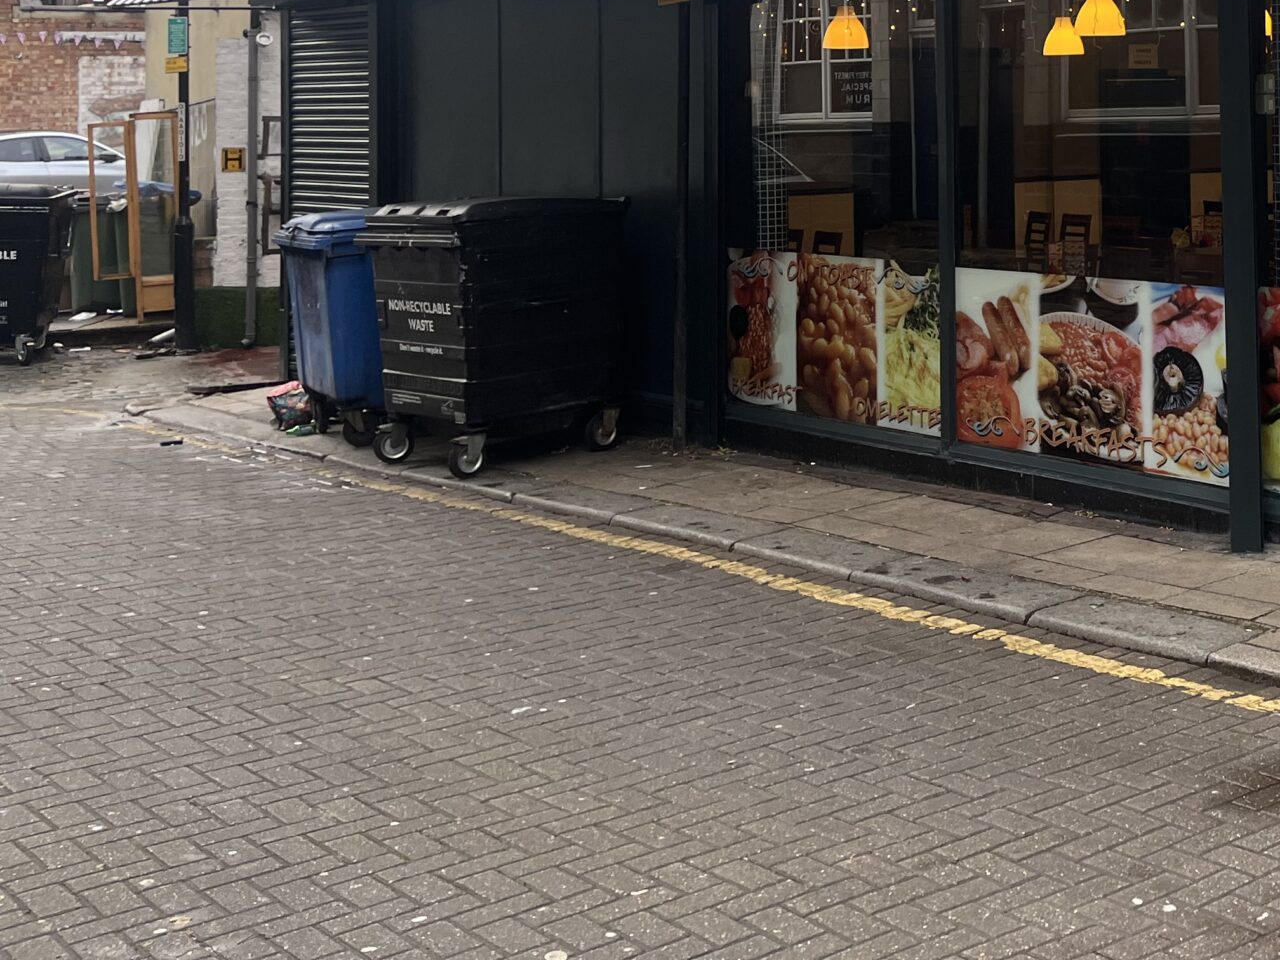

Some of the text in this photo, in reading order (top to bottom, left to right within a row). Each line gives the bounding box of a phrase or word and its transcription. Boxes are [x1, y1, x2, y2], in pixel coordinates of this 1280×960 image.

[786, 259, 877, 291] ON TOAST
[388, 298, 452, 316] NON-RECYCLABLE
[407, 318, 435, 332] WASTE
[731, 378, 803, 404] BREAKFAST
[1022, 416, 1171, 468] BREAKFASTS
